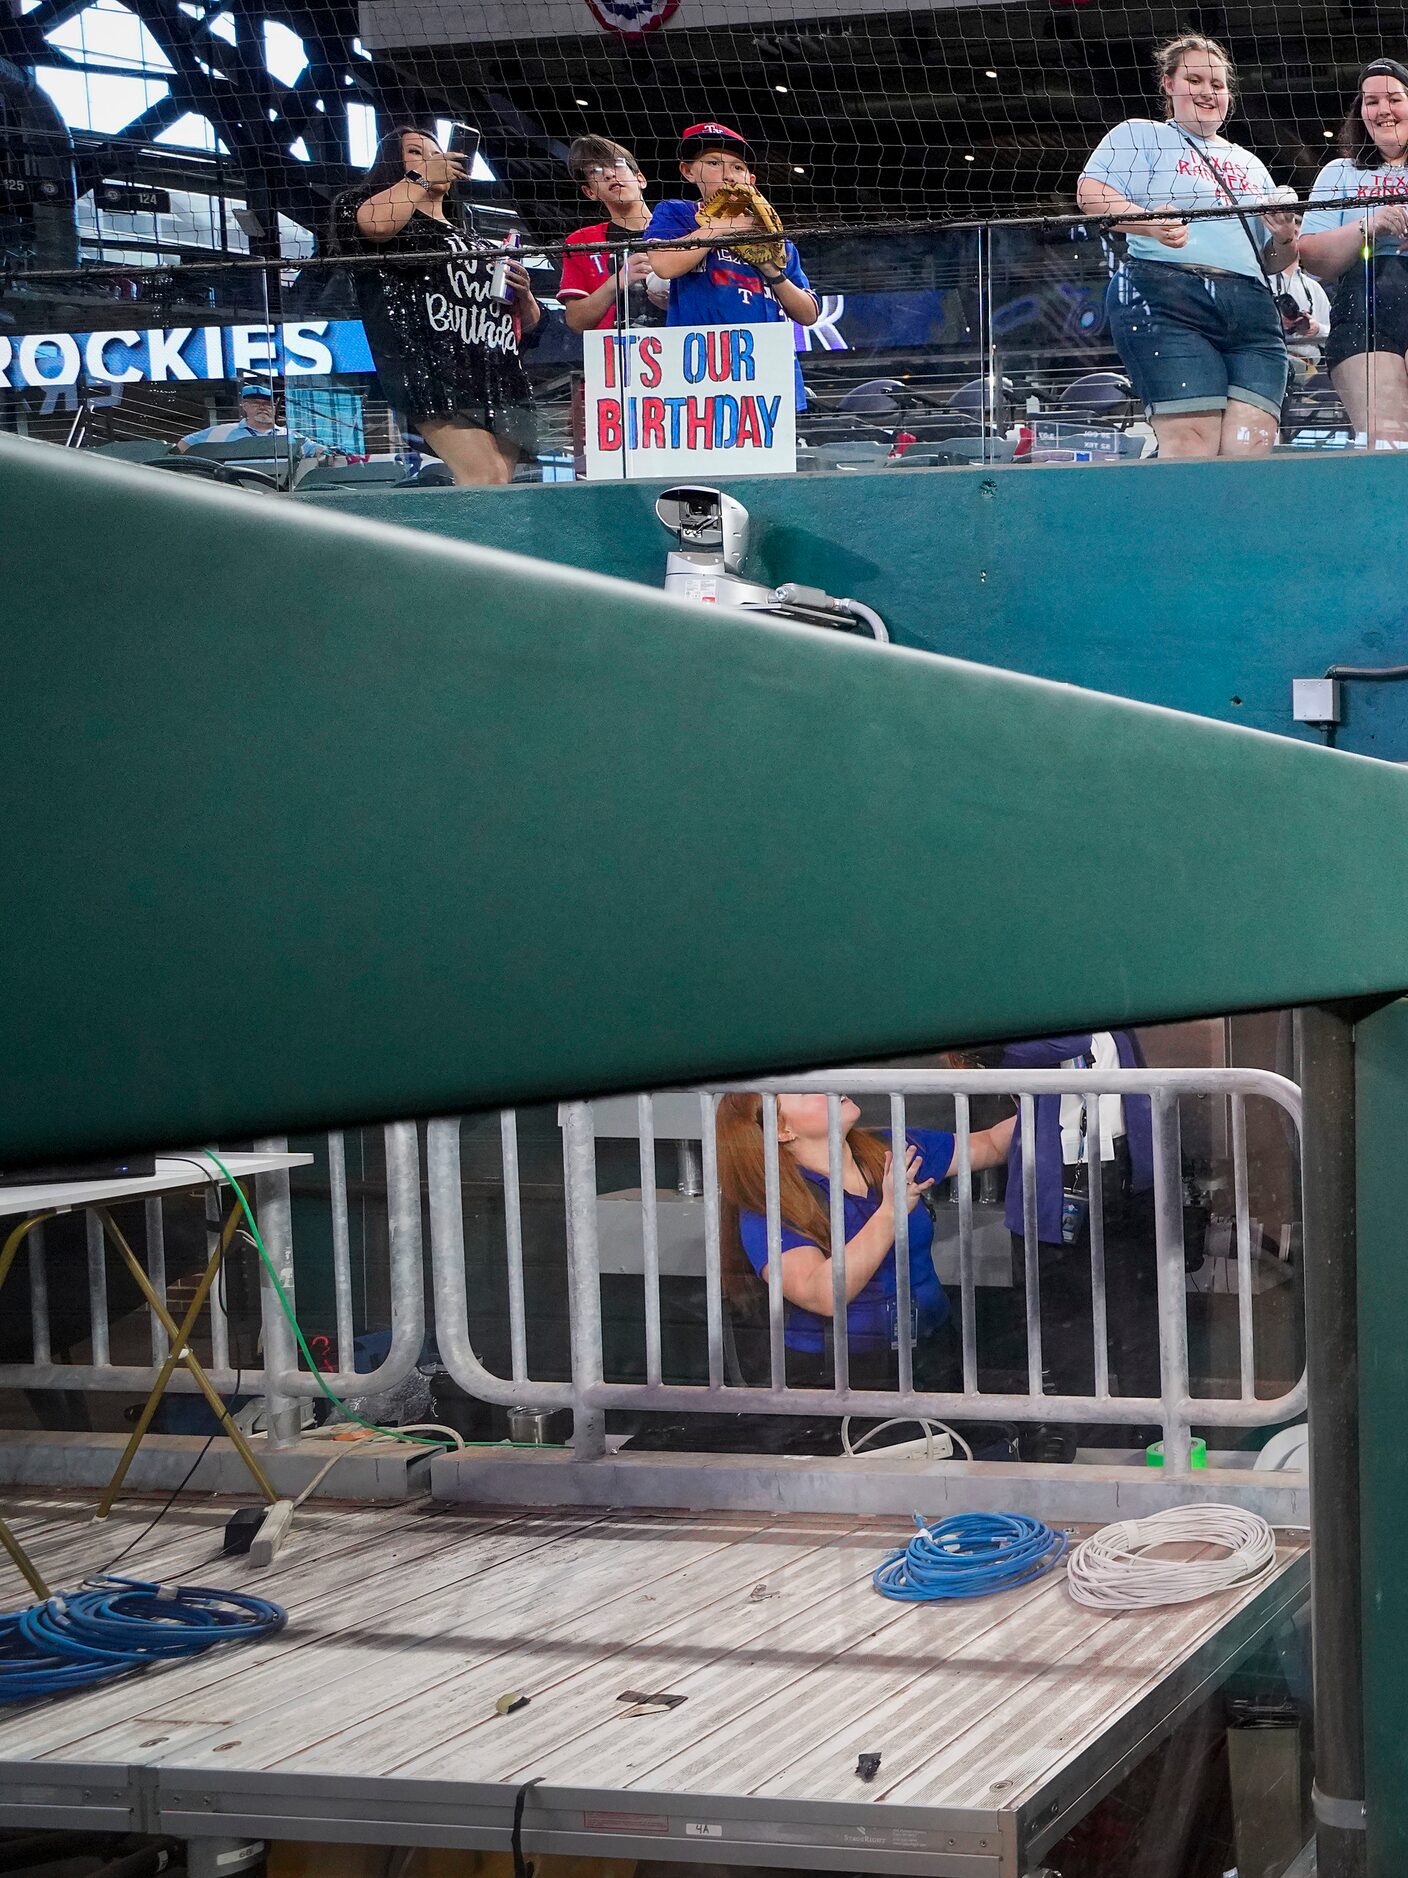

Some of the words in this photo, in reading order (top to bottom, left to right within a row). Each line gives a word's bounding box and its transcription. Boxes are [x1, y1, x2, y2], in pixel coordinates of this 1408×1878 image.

[138, 193, 157, 205] 124
[0, 321, 333, 387] OCKIES
[426, 293, 520, 357] Birthda
[603, 335, 663, 388] IT'S
[683, 329, 755, 384] OUR
[597, 394, 782, 451] BIRTHDAY
